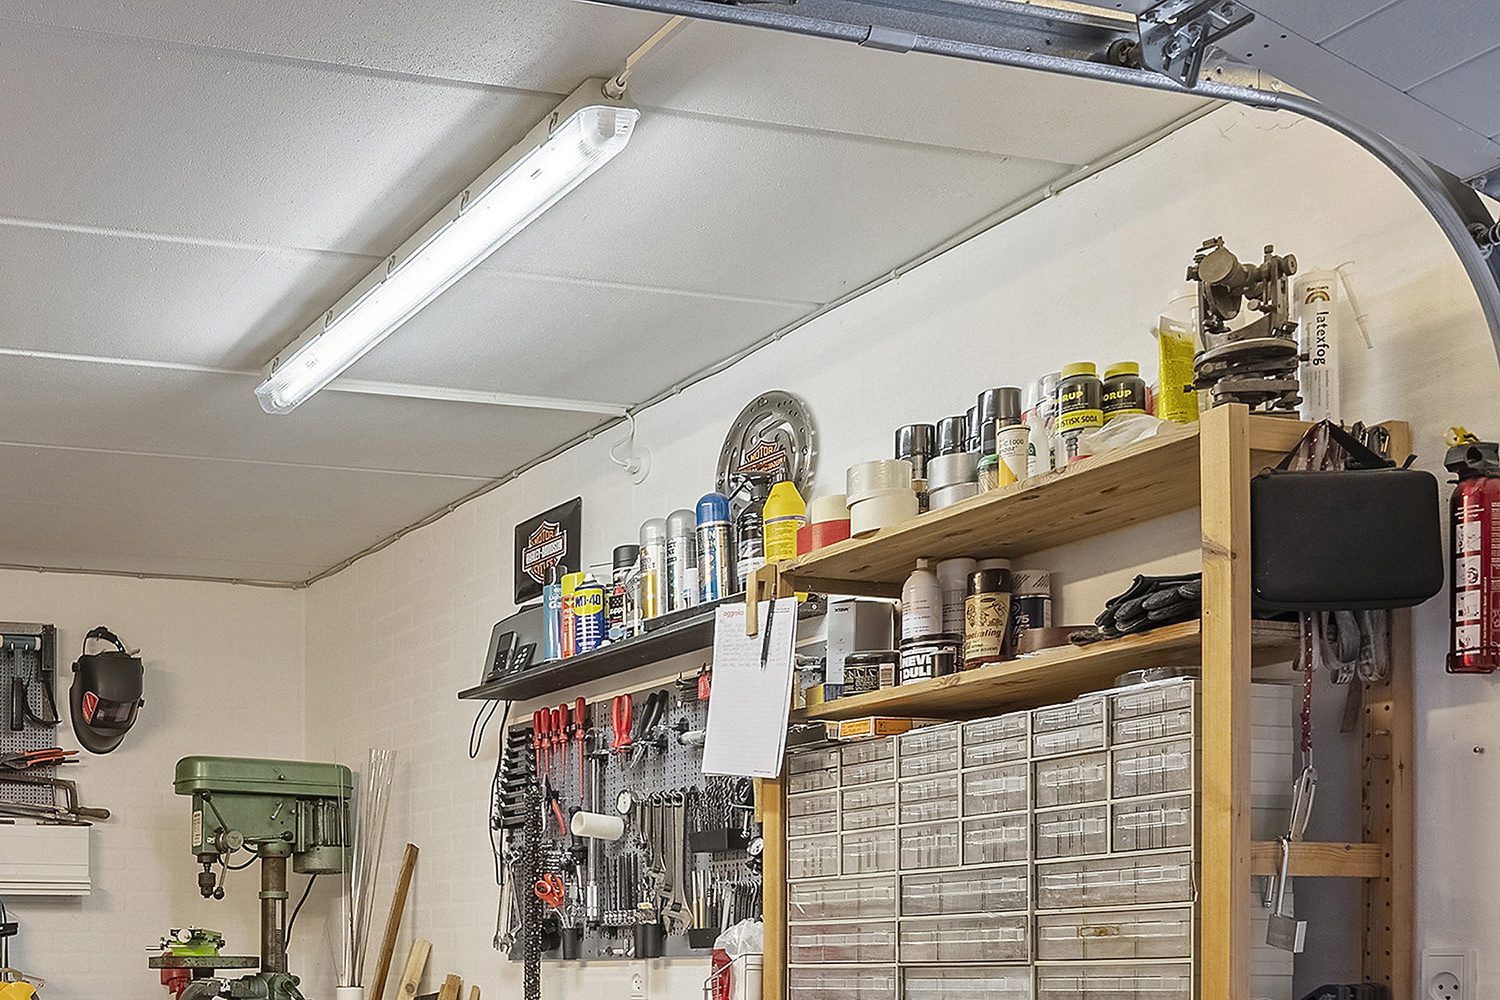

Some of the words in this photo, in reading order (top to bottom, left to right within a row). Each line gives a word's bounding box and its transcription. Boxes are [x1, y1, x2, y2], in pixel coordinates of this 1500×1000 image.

[1313, 311, 1329, 366] latexfog
[1102, 388, 1132, 402] ORUP
[1081, 415, 1098, 424] SODA
[575, 593, 601, 608] WD-40
